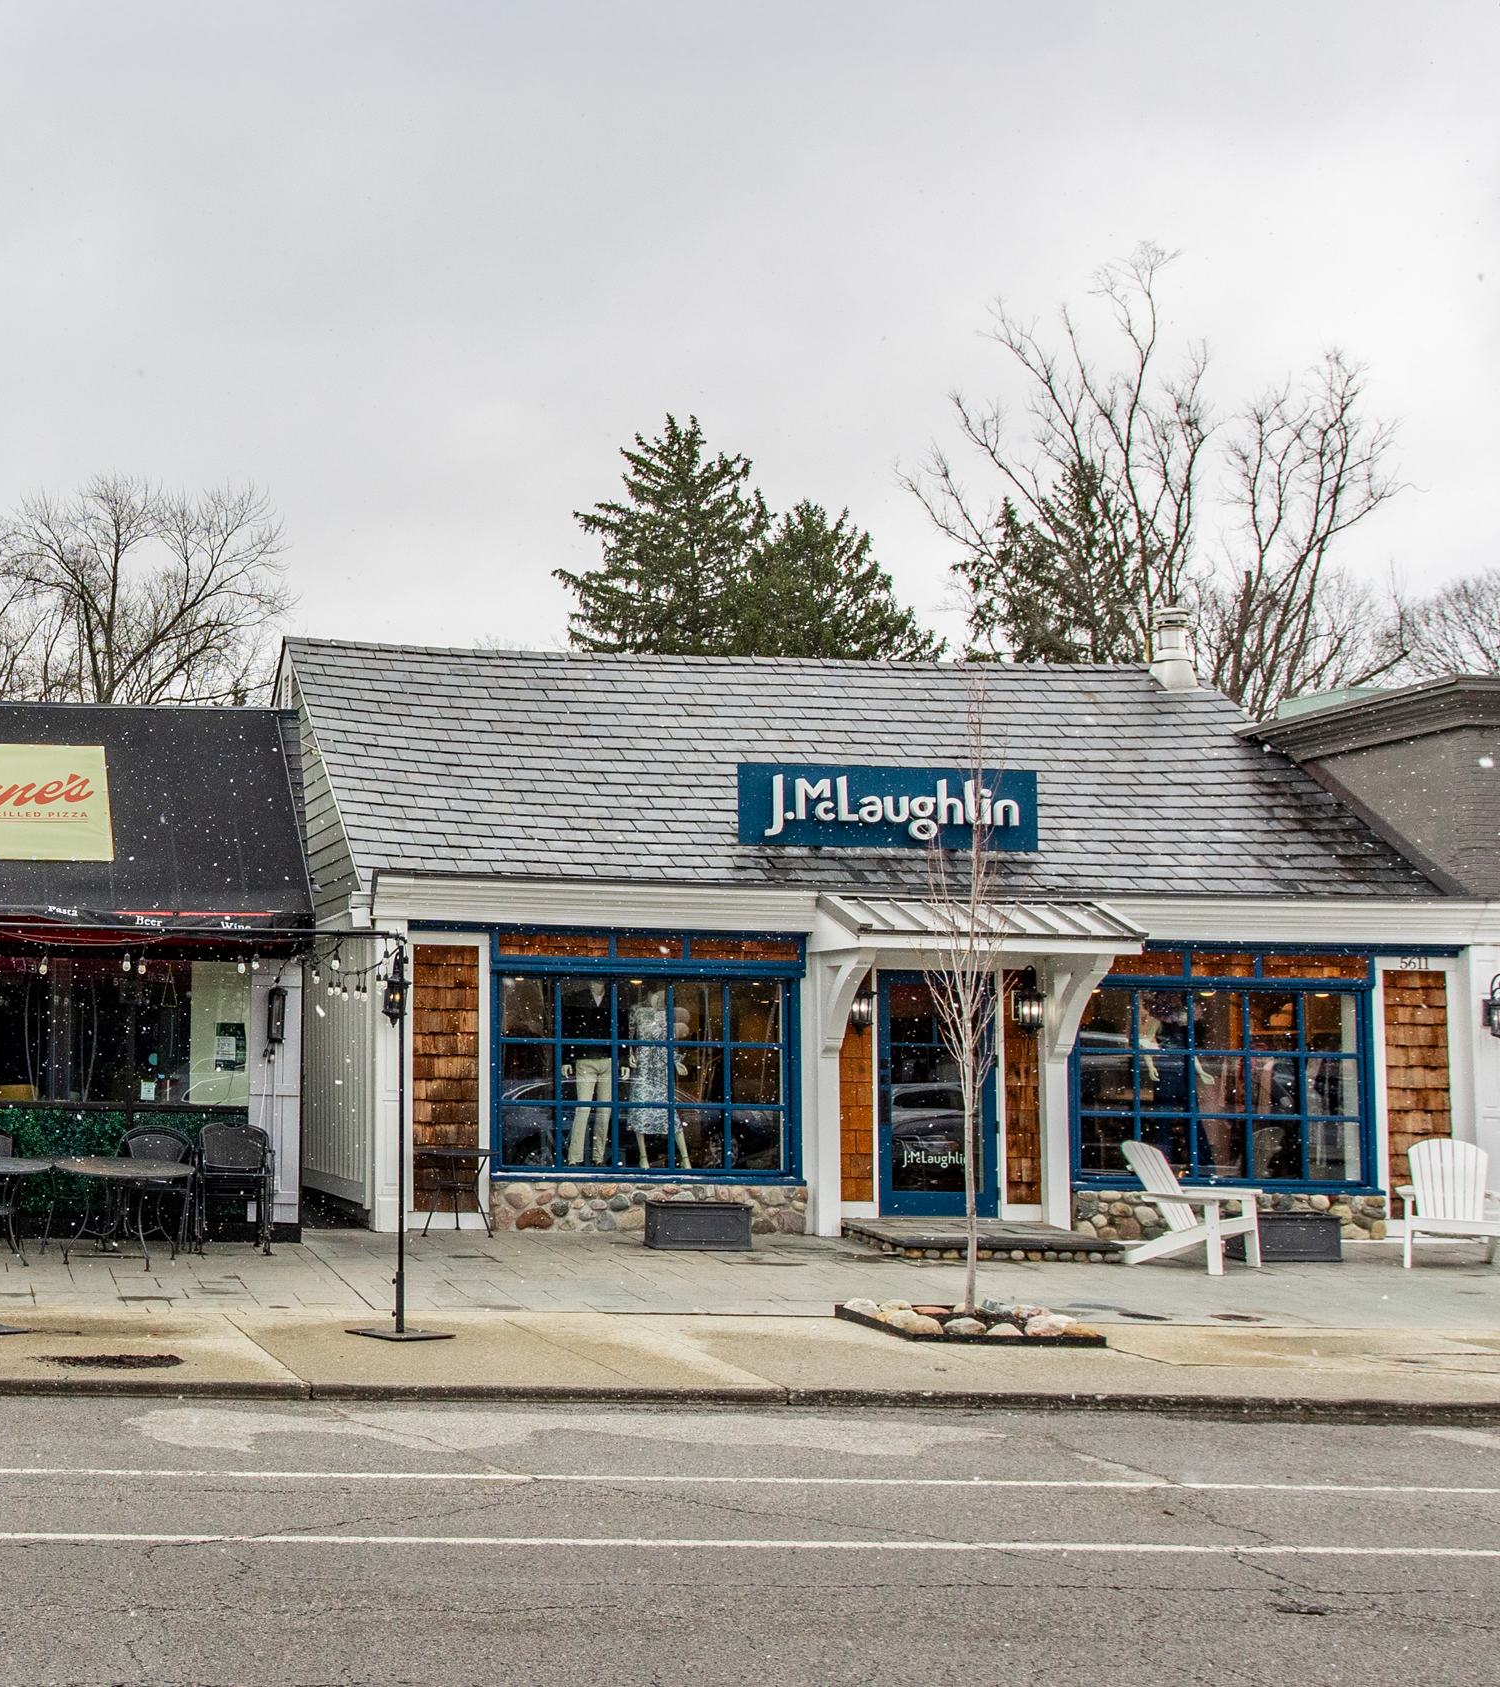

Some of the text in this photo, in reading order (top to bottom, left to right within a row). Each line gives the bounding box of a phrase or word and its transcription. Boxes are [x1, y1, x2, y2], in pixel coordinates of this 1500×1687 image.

[764, 773, 1020, 841] J.McLaughlin
[48, 905, 79, 917] Pasta
[135, 915, 163, 927] Beer
[1400, 956, 1429, 970] 5611
[902, 1150, 966, 1168] J.McLaughli
